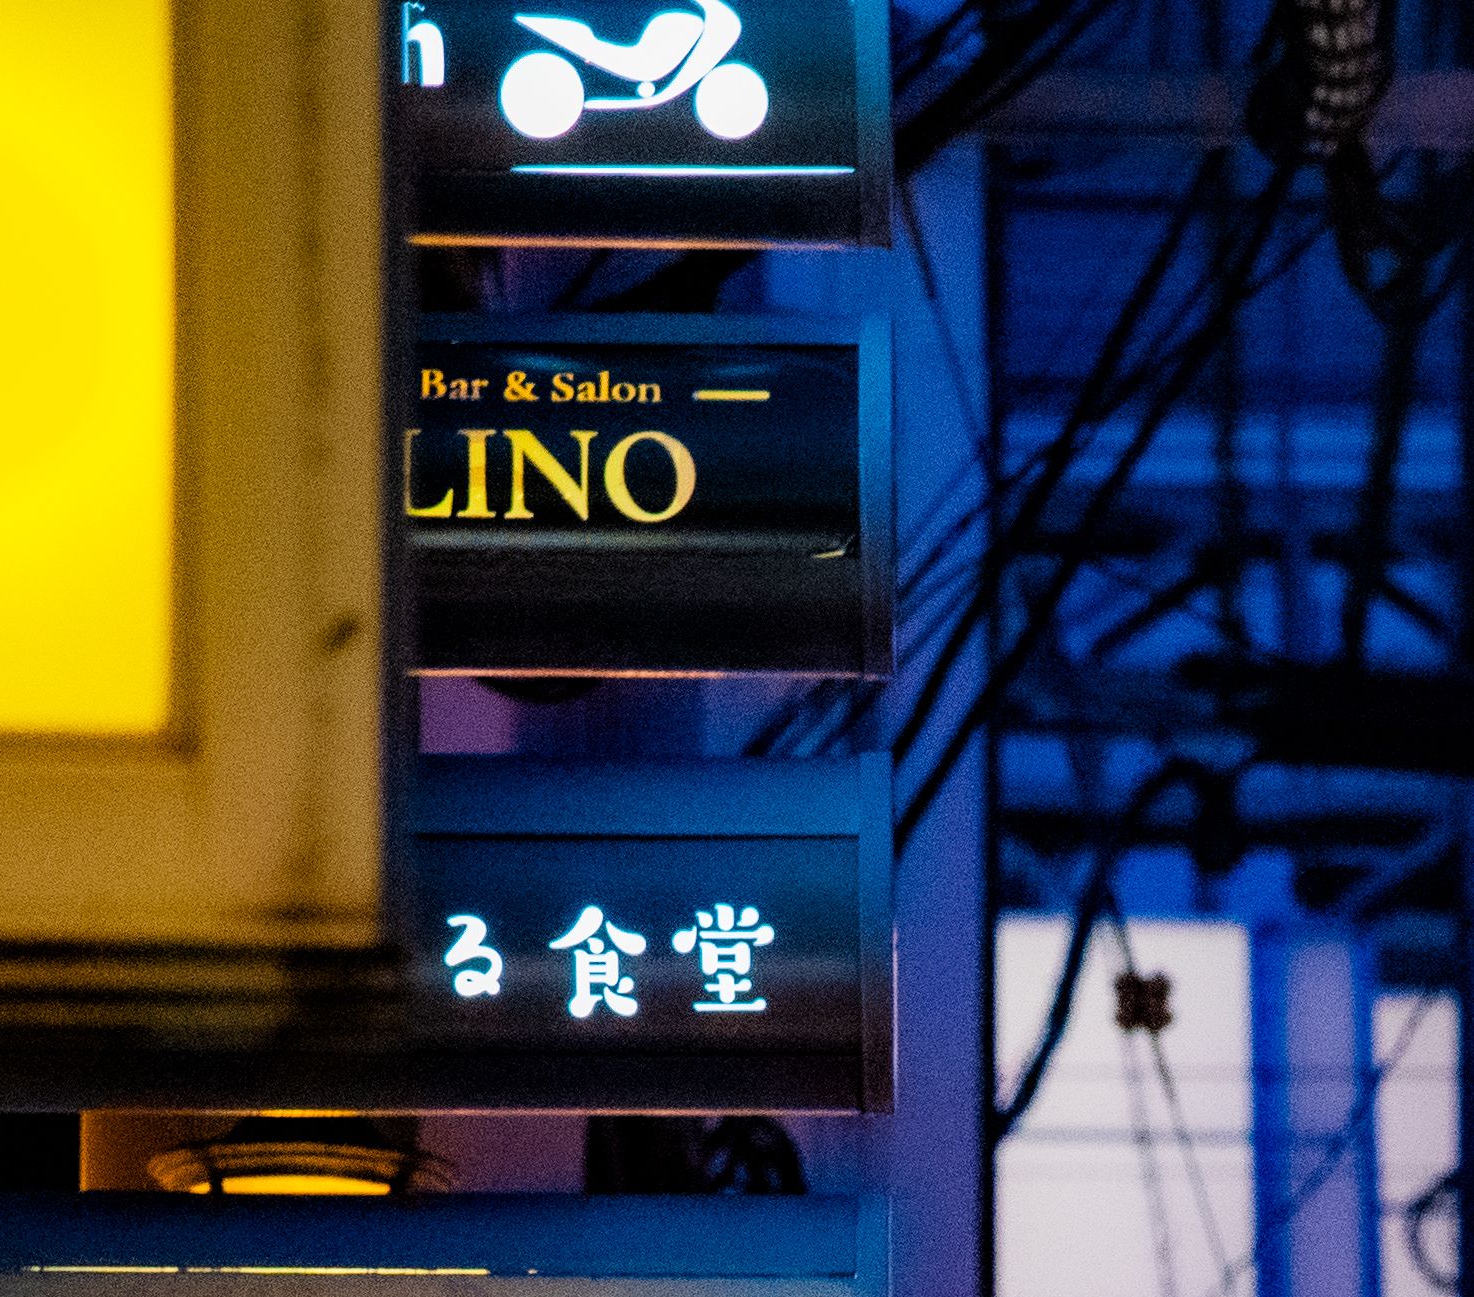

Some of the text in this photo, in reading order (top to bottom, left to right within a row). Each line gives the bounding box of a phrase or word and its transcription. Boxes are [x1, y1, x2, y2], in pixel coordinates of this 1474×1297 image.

[420, 369, 662, 404] Bar & Salon
[443, 902, 775, 1019] る食堂
